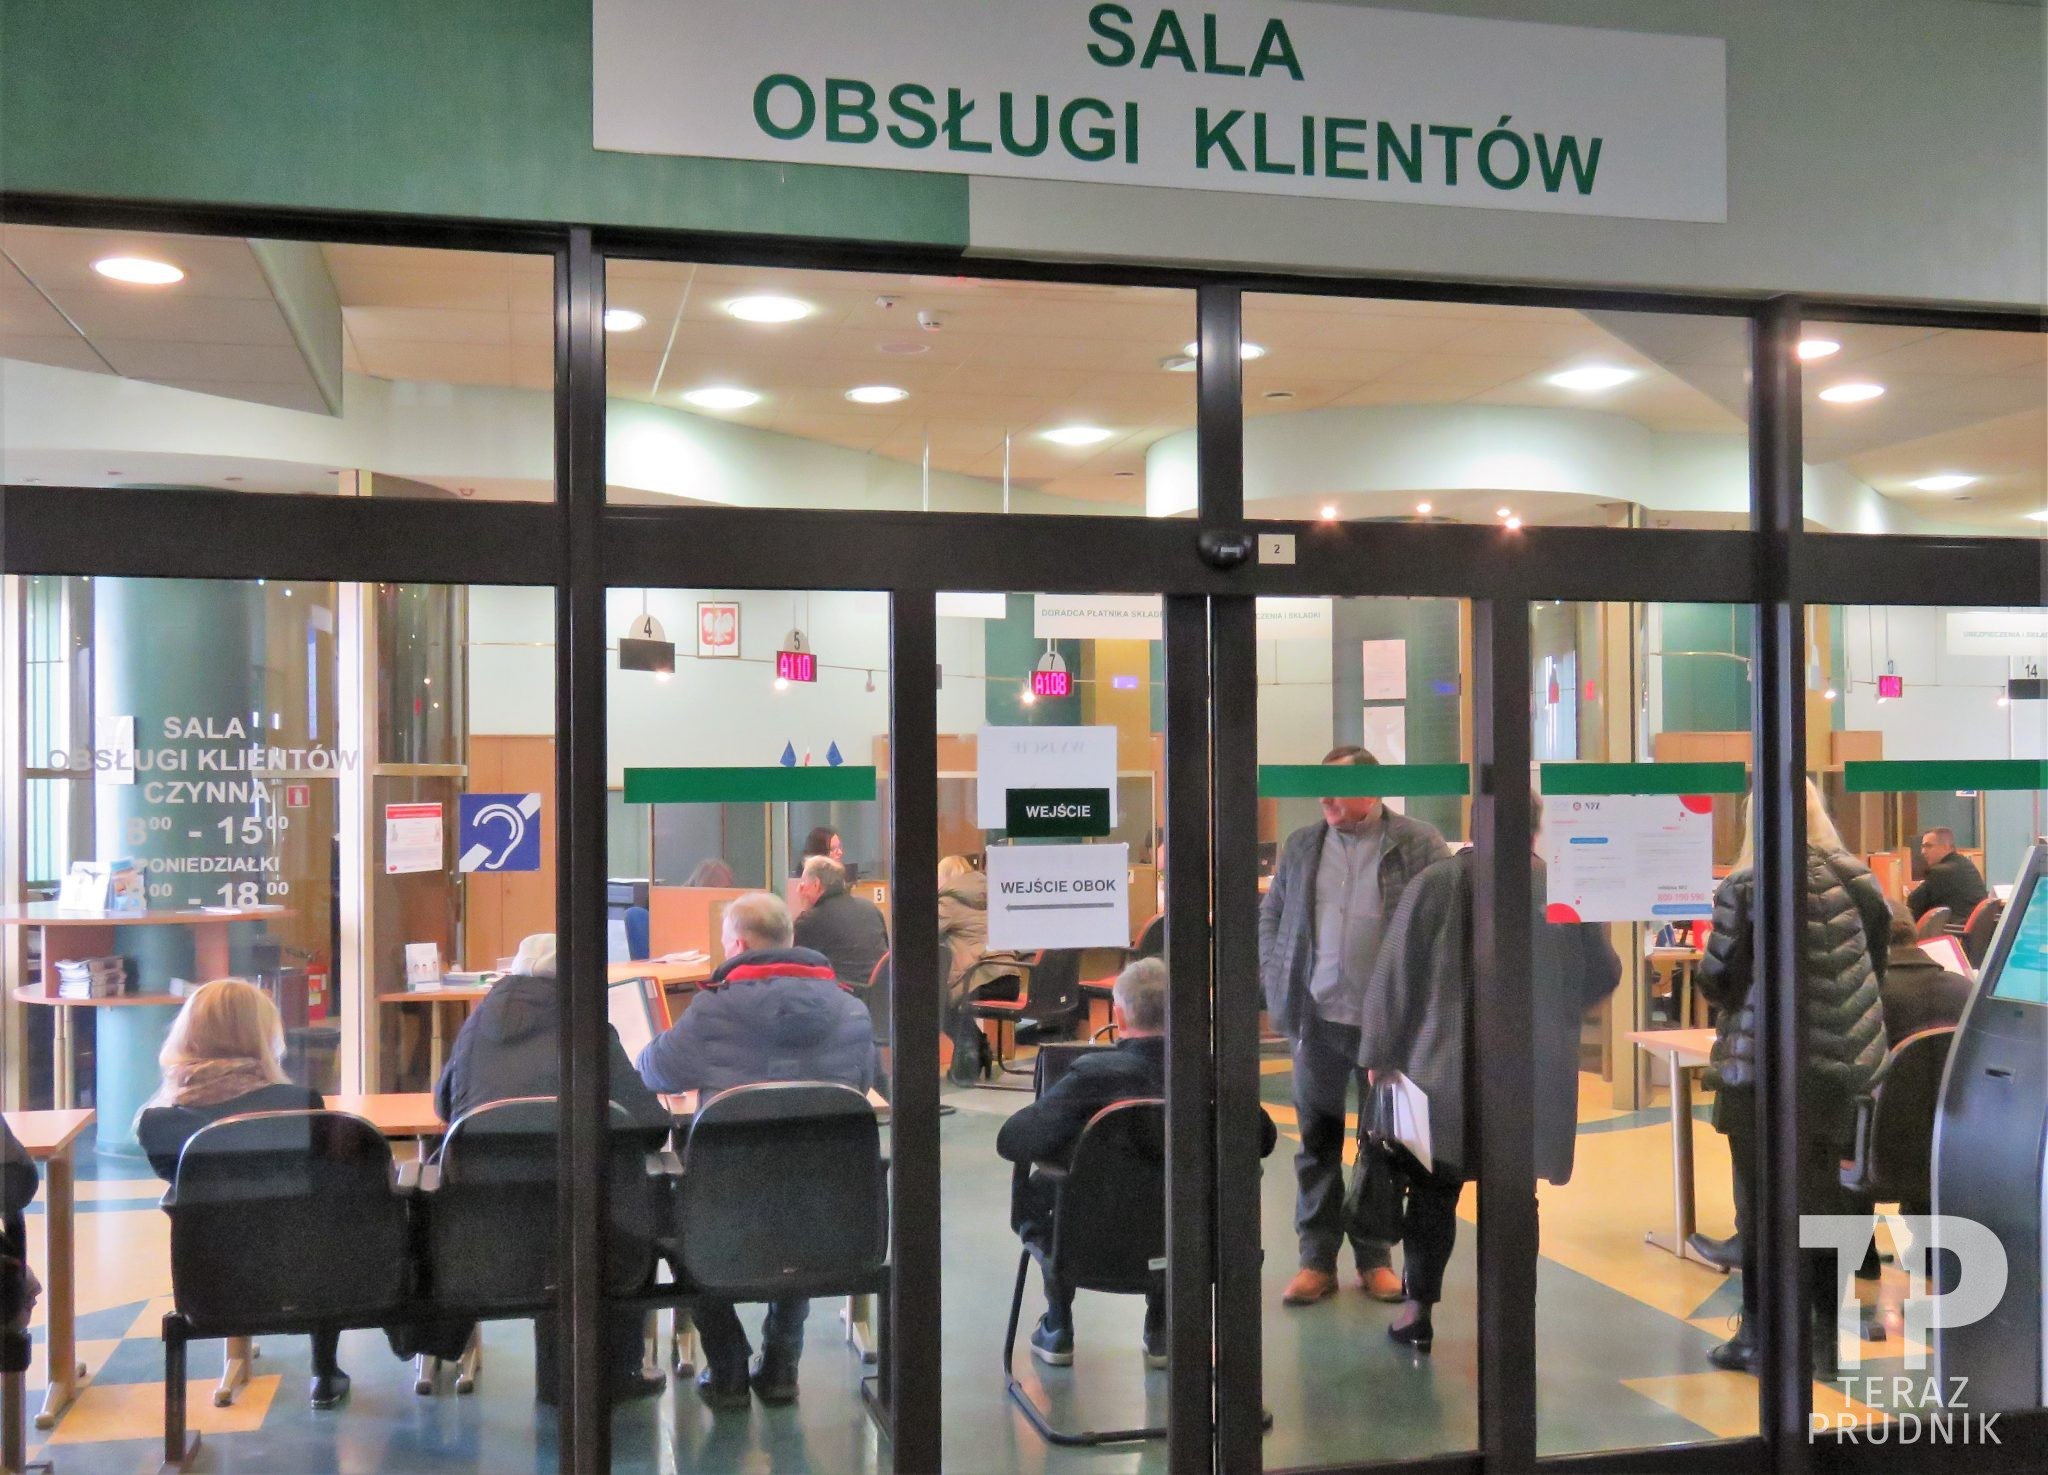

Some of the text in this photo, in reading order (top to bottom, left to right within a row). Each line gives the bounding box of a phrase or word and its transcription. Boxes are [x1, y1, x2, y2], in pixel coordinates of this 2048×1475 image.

[1086, 3, 1305, 82] SALA
[752, 72, 1604, 196] OBSŁUGI KLIENTÓW
[1273, 543, 1281, 554] 2
[1041, 608, 1085, 617] DORADCA
[1086, 609, 1129, 618] PŁATNIKA
[643, 616, 652, 638] 4
[793, 631, 801, 650] 5
[780, 653, 811, 681] A110
[1048, 653, 1056, 670] 7
[2024, 663, 2038, 678] 14
[162, 715, 246, 740] SALA
[49, 743, 359, 772] OBSŁUGI KLIENTÓW
[143, 780, 272, 804] CZYNNA
[1025, 802, 1092, 819] WEJŚCIE
[136, 856, 280, 873] PONIEDZIAŁKI
[876, 888, 882, 901] 5
[1000, 877, 1117, 894] WEJŚCIE OBOK
